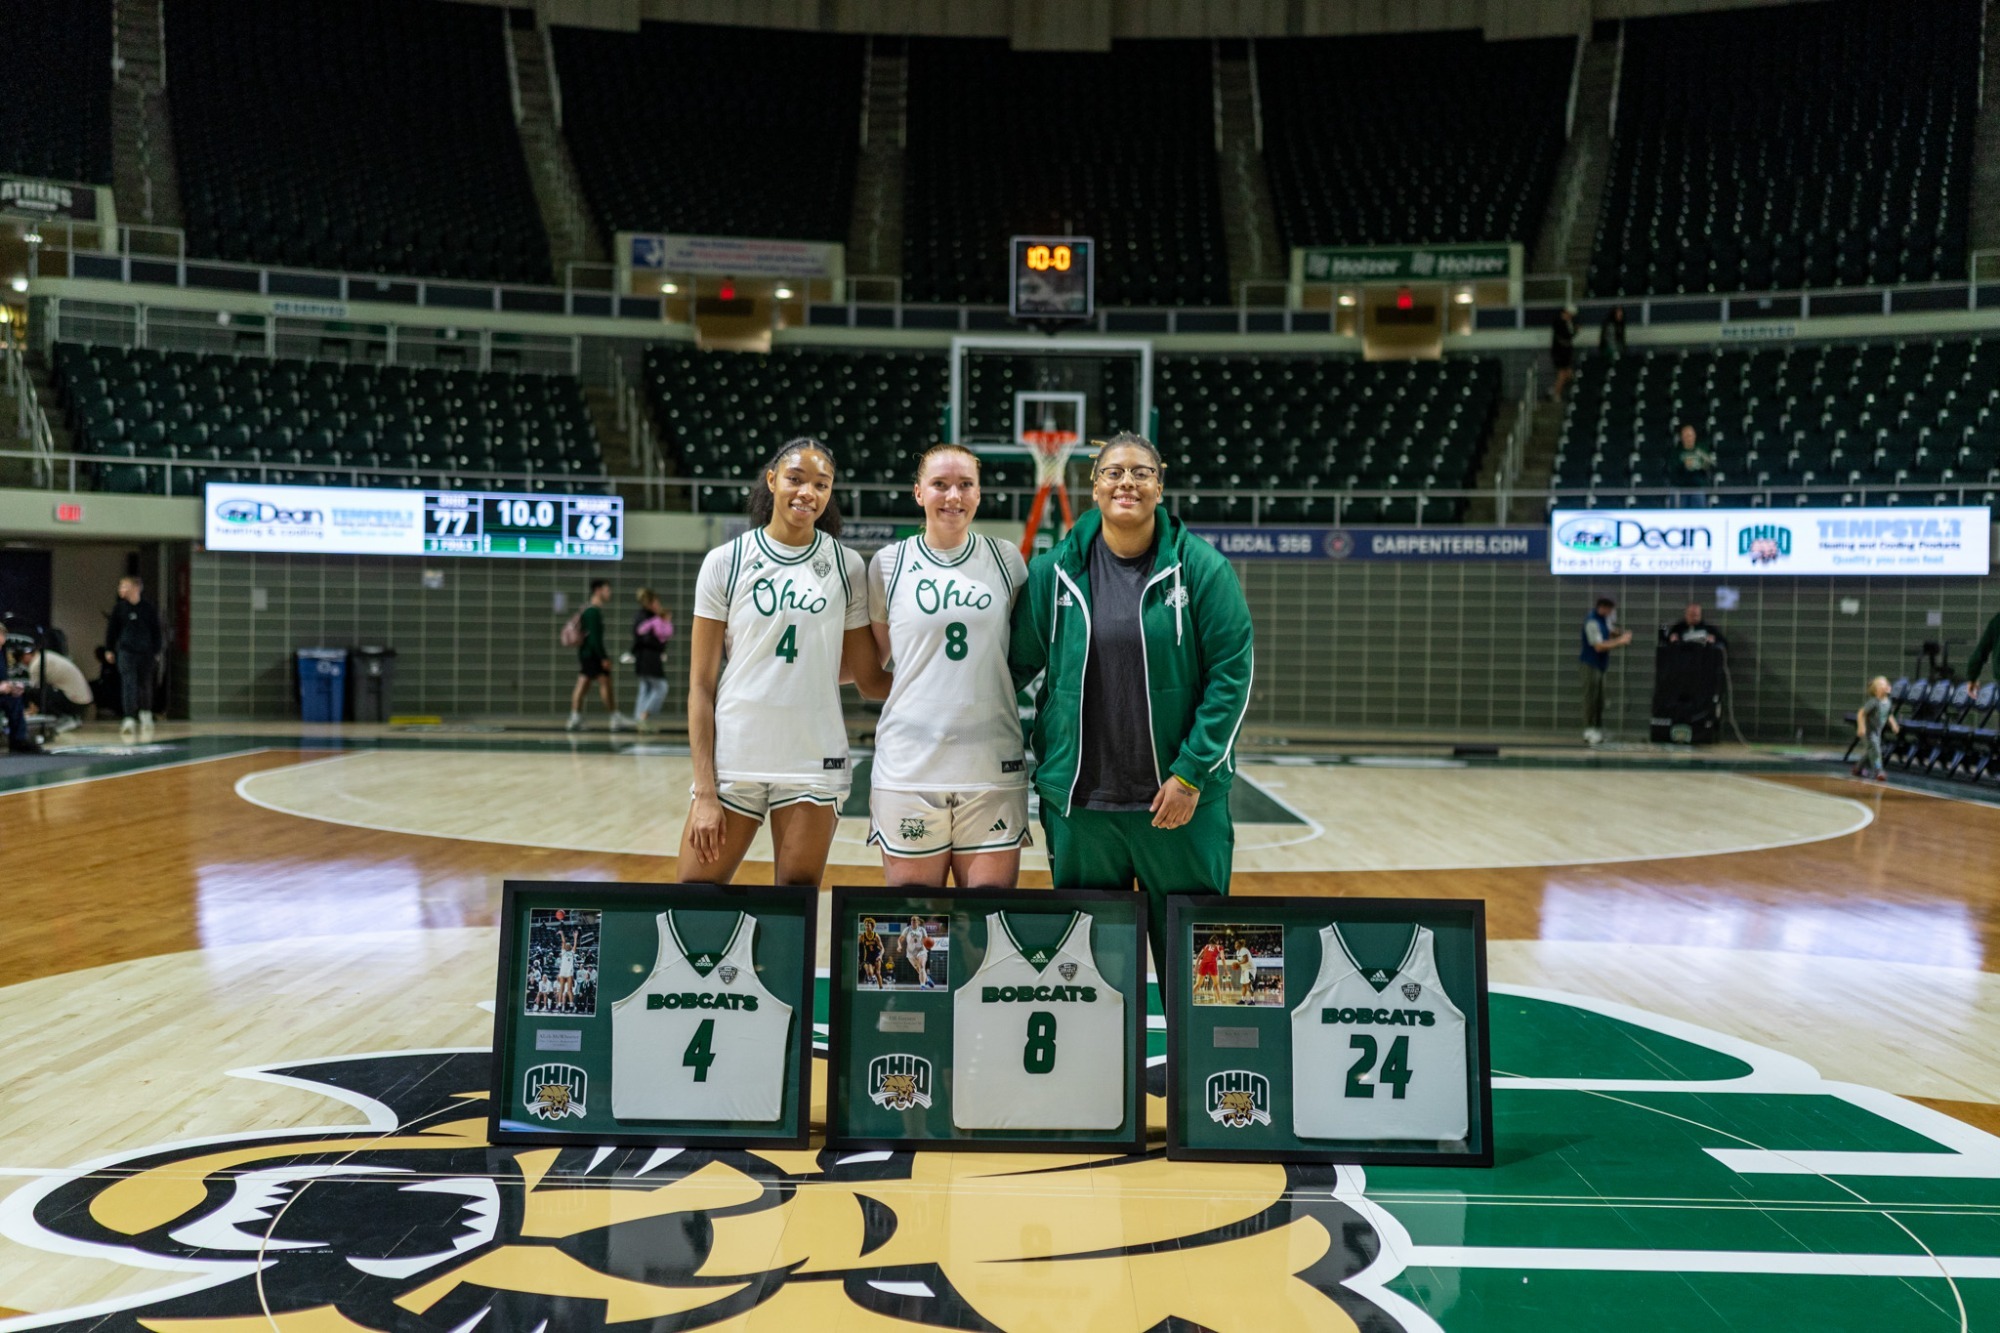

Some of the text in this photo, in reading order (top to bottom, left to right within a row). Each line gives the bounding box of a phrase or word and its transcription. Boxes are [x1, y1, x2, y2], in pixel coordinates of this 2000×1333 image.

[1332, 256, 1400, 275] Holzer
[1437, 254, 1506, 273] Holzer
[257, 502, 324, 525] Dean
[432, 510, 470, 537] 77
[497, 499, 555, 527] 10.0
[576, 514, 612, 541] 62
[1221, 534, 1273, 552] LOCAL
[1372, 535, 1528, 554] CARPENTERS.COM
[1617, 519, 1711, 549] Dean
[1738, 524, 1792, 556] OHIO
[1557, 555, 1712, 573] heating & cooling
[753, 578, 827, 617] Ohio
[916, 578, 992, 615] Ohio
[775, 624, 798, 664] 4
[945, 621, 969, 662] 8
[646, 992, 759, 1012] BOBCATS
[981, 984, 1097, 1003] BOBCATS
[1321, 1007, 1436, 1027] BOBCATS
[682, 1019, 716, 1082] 4
[1023, 1011, 1057, 1074] 8
[868, 1054, 932, 1096] OHIO
[1344, 1034, 1413, 1100] 24
[524, 1064, 587, 1106] OHIO
[1206, 1070, 1270, 1112] OHIO
